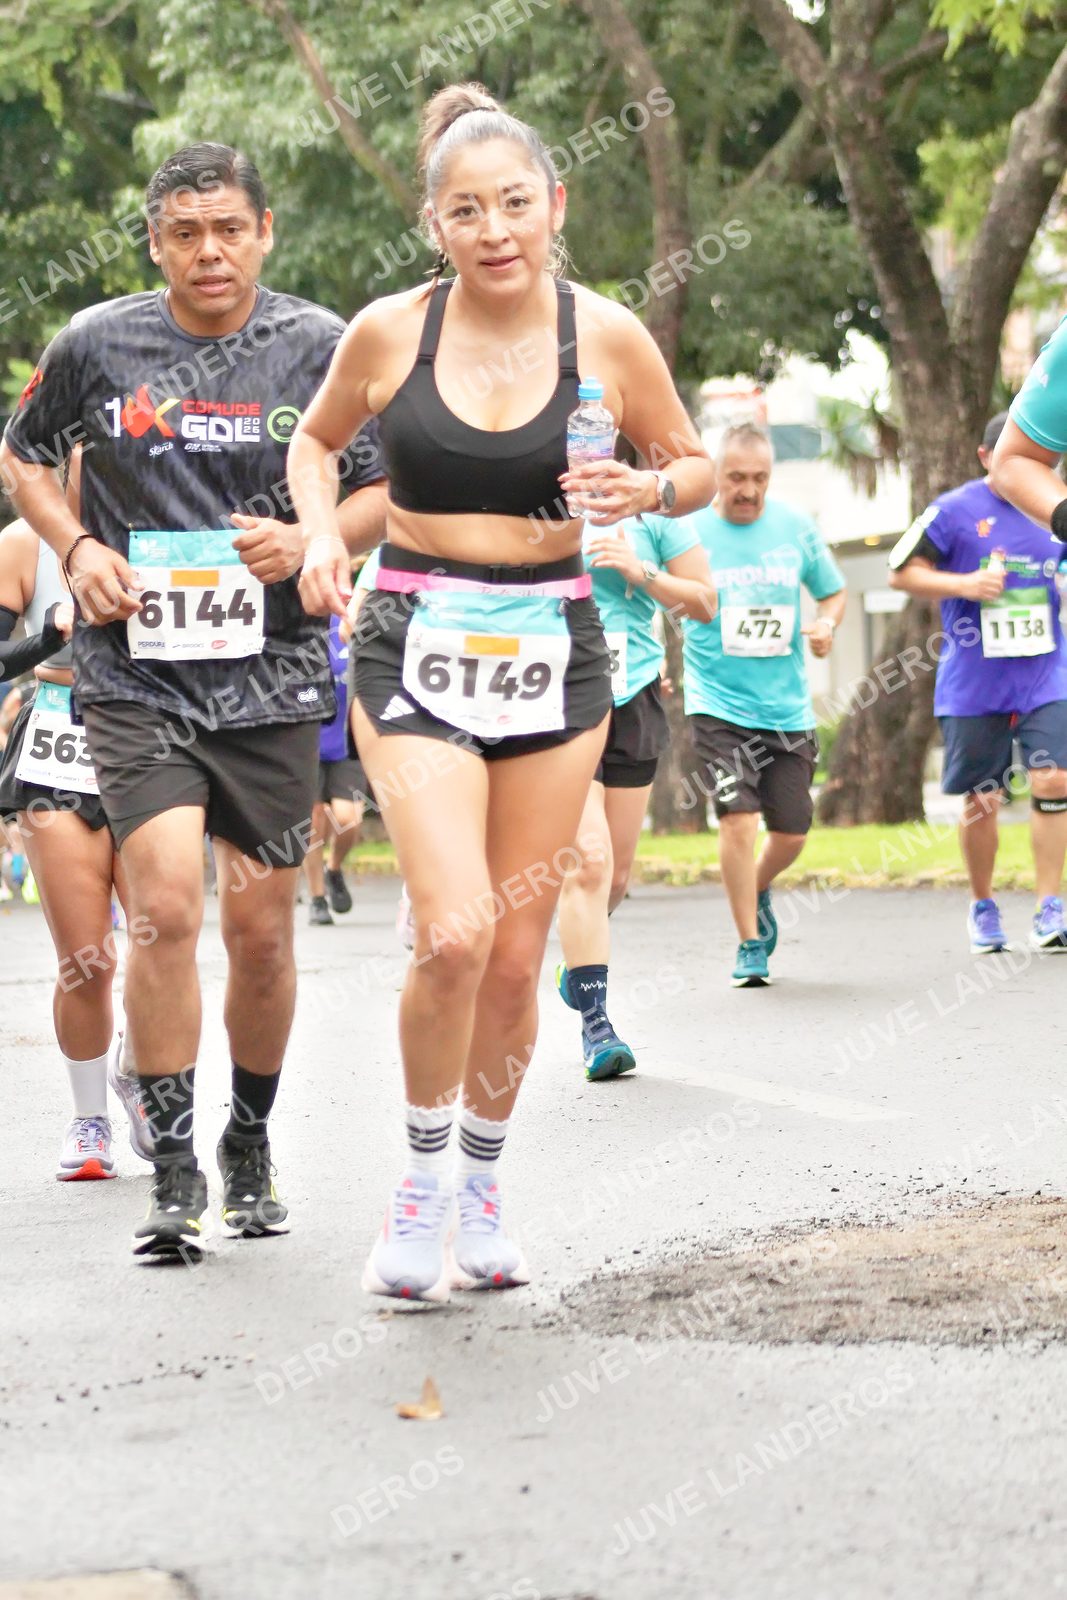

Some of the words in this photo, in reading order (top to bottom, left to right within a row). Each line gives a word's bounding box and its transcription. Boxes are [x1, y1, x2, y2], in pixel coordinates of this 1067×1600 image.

[181, 400, 261, 416] COMUDE
[181, 415, 260, 442] GDL
[138, 587, 256, 629] 6144
[737, 619, 782, 638] 472
[990, 619, 1045, 640] 1138
[417, 653, 552, 701] 6149
